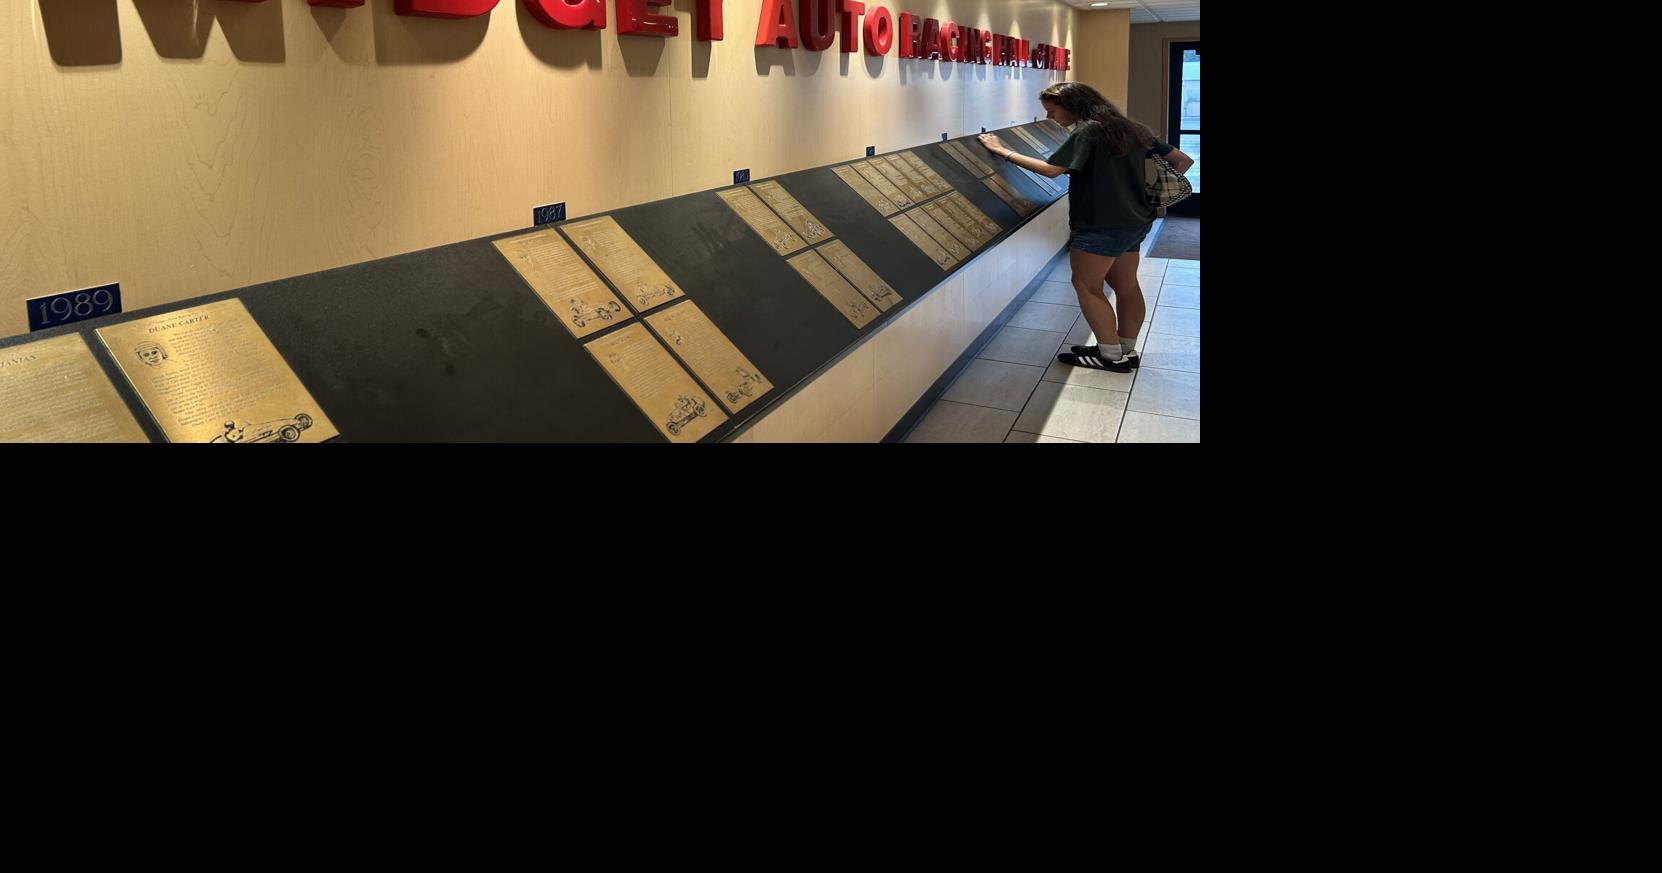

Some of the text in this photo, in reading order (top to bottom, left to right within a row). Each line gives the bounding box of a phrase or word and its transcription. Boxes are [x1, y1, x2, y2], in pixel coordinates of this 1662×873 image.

[754, 0, 893, 57] AUTO
[899, 12, 993, 64] RACING
[537, 204, 563, 223] 1987
[40, 289, 114, 325] 1989
[148, 322, 178, 334] DUANE
[178, 314, 209, 326] CARTER
